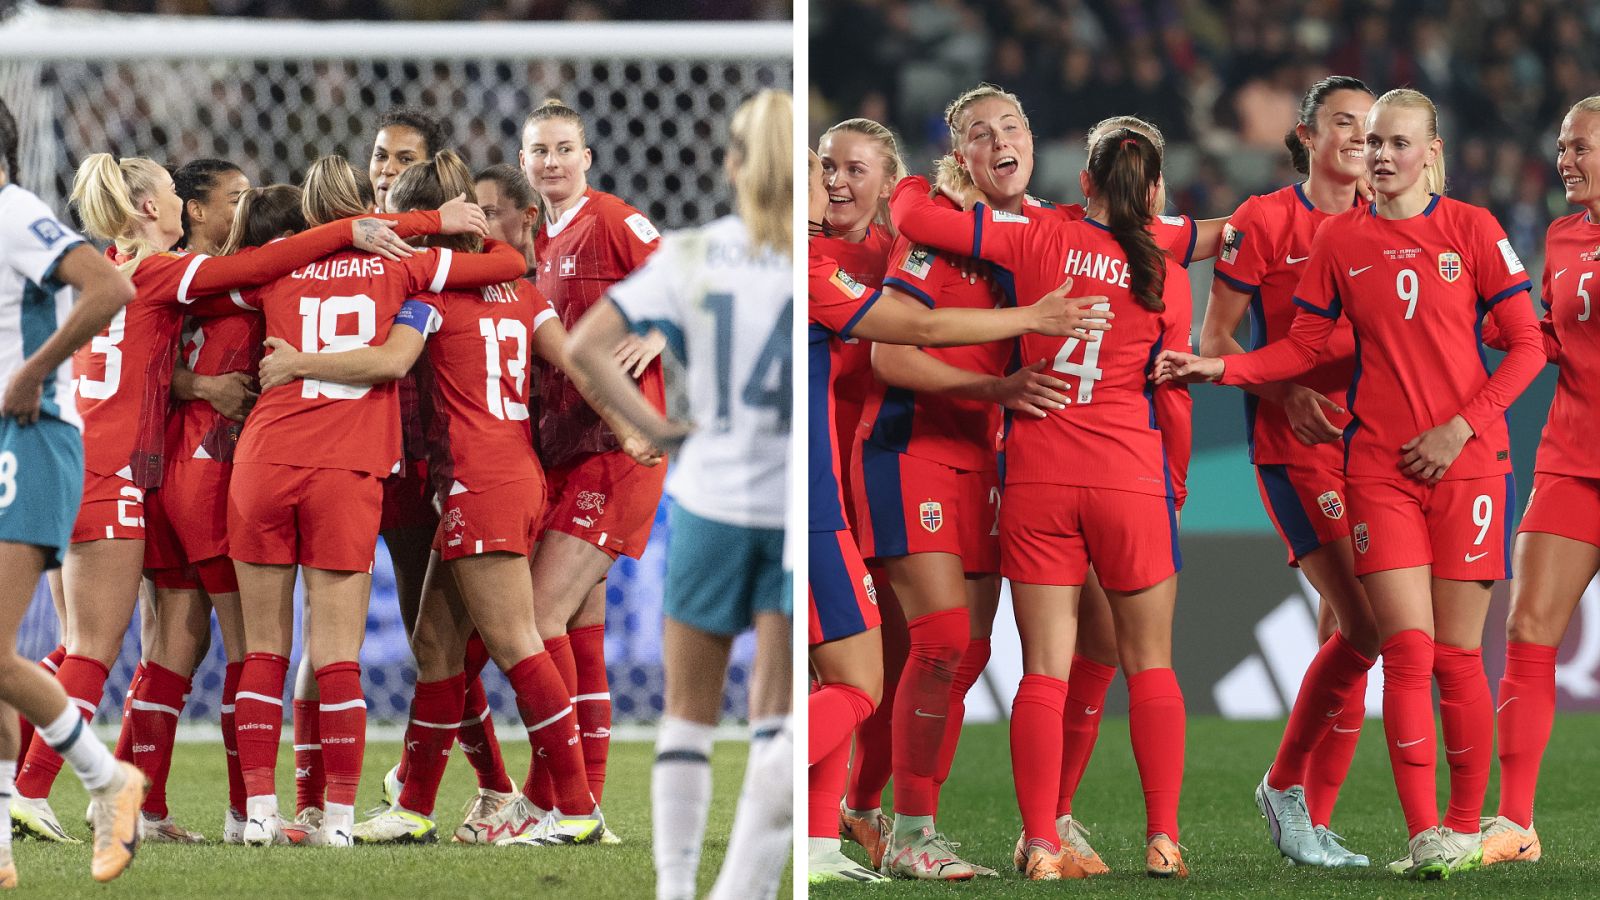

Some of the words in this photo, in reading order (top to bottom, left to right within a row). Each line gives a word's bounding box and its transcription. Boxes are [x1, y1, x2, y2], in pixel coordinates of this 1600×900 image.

[1064, 249, 1131, 289] HANSE
[1396, 268, 1419, 320] 9
[1577, 271, 1593, 321] 5
[299, 294, 376, 399] 18
[479, 318, 530, 421] 13
[703, 292, 792, 433] 14
[1052, 303, 1111, 404] 4
[1472, 494, 1493, 545] 9
